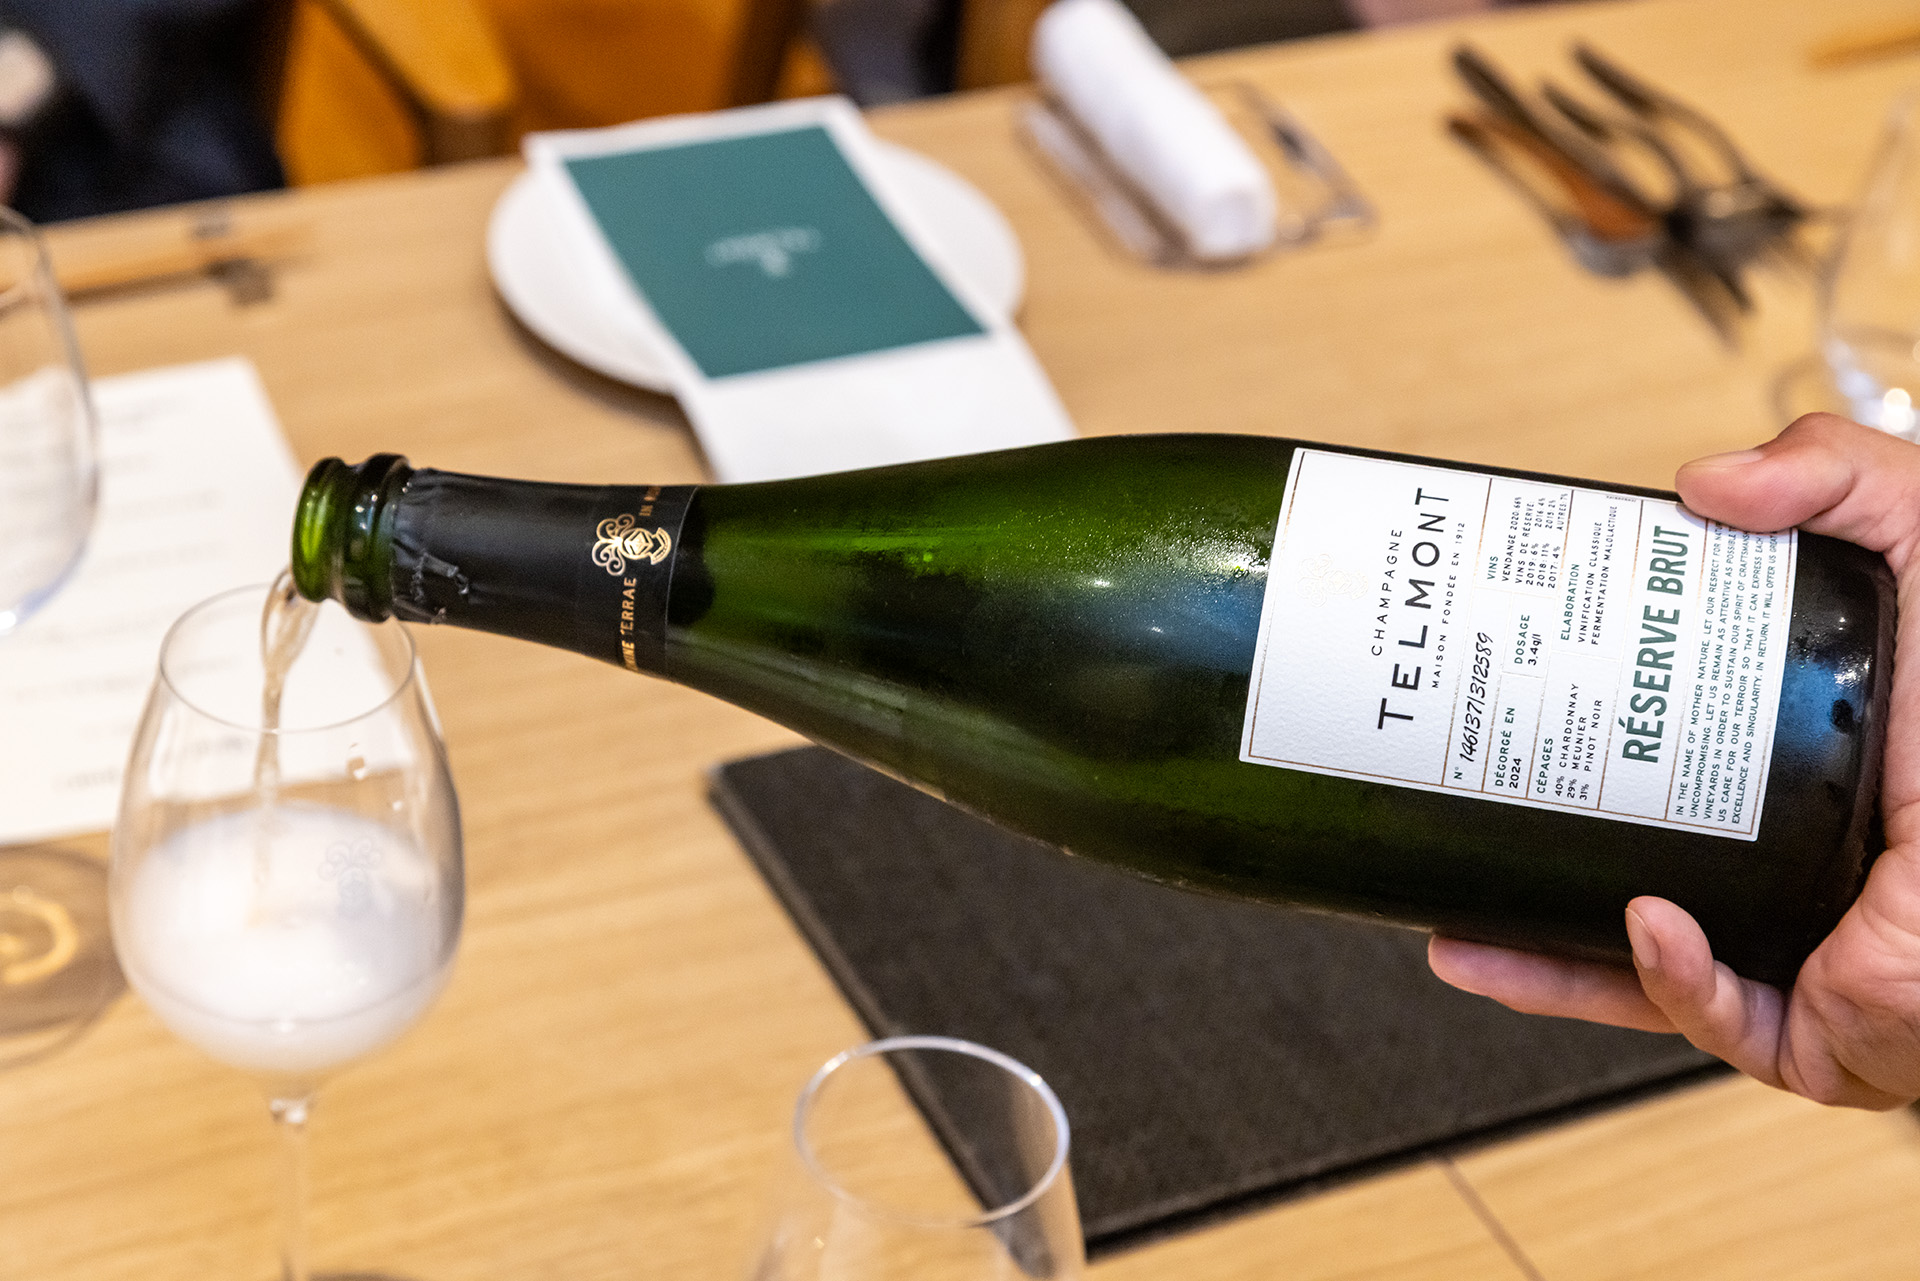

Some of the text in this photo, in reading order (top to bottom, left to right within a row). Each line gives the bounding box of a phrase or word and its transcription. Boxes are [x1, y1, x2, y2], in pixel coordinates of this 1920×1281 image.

[1502, 534, 1516, 581] VENDANGE
[1519, 542, 1529, 554] DE
[1712, 543, 1721, 556] FOR
[1726, 533, 1737, 565] POSSIBLE
[1768, 555, 1777, 564] US
[1487, 556, 1499, 580] VINS
[1515, 560, 1526, 584] VINS
[1591, 506, 1617, 645] FERMENTATION MALOLACTIQUE
[1708, 559, 1719, 593] RESPECT
[1725, 567, 1733, 577] AS
[1751, 556, 1762, 589] EXPRESS
[1765, 566, 1775, 589] OFFER
[1371, 529, 1402, 656] CHAMPAGNE
[1578, 522, 1602, 643] VINIFICATION CLASSIQUE
[1737, 580, 1745, 591] OF
[1377, 487, 1449, 730] TELMONT
[1431, 523, 1465, 689] MAISON FONDÉE EN 1912
[1560, 564, 1580, 641] ELABORATION
[1705, 596, 1715, 615] OUR
[1719, 580, 1732, 624] ATTENTIVE
[1733, 594, 1744, 621] SPIRIT
[1749, 593, 1758, 611] CAN
[1764, 591, 1773, 608] WILL
[1703, 619, 1712, 635] LET
[1747, 615, 1756, 623] IT
[1762, 611, 1770, 619] IT
[1514, 614, 1530, 664] DOSAGE
[1618, 525, 1689, 763] RÉSERVE BRUT
[1717, 628, 1726, 641] AS
[1730, 624, 1740, 644] OUR
[1743, 628, 1754, 651] THAT
[1711, 644, 1723, 681] REMAIN
[1724, 647, 1737, 689] SUSTAIN
[1741, 656, 1751, 670] SO
[1756, 661, 1764, 671] IN
[1709, 685, 1718, 699] US
[1721, 693, 1731, 705] TO
[1734, 675, 1748, 717] TERROIR
[1690, 684, 1703, 725] MOTHER
[1705, 703, 1715, 721] LET
[1687, 730, 1696, 744] OF
[1716, 710, 1728, 745] ORDER
[1730, 723, 1741, 745] OUR
[1494, 707, 1515, 787] DÉGORGÉ EN
[1555, 683, 1579, 797] 40% CHARDONNAY
[1579, 700, 1602, 801] 31% PINOT NOIR
[1742, 741, 1752, 763] AND
[1536, 738, 1554, 794] CÉPAGES
[1566, 716, 1587, 799] 29% MEUNIER
[1682, 748, 1694, 778] NAME
[1713, 749, 1722, 759] IN
[1726, 750, 1737, 771] FOR
[1509, 758, 1522, 789] 2024
[1677, 782, 1688, 800] THE
[1703, 764, 1720, 820] VINEYARDS
[1720, 776, 1733, 803] CARE
[1731, 766, 1749, 824] EXCELLENCE
[1675, 805, 1684, 816] IN
[1717, 808, 1727, 822] US
